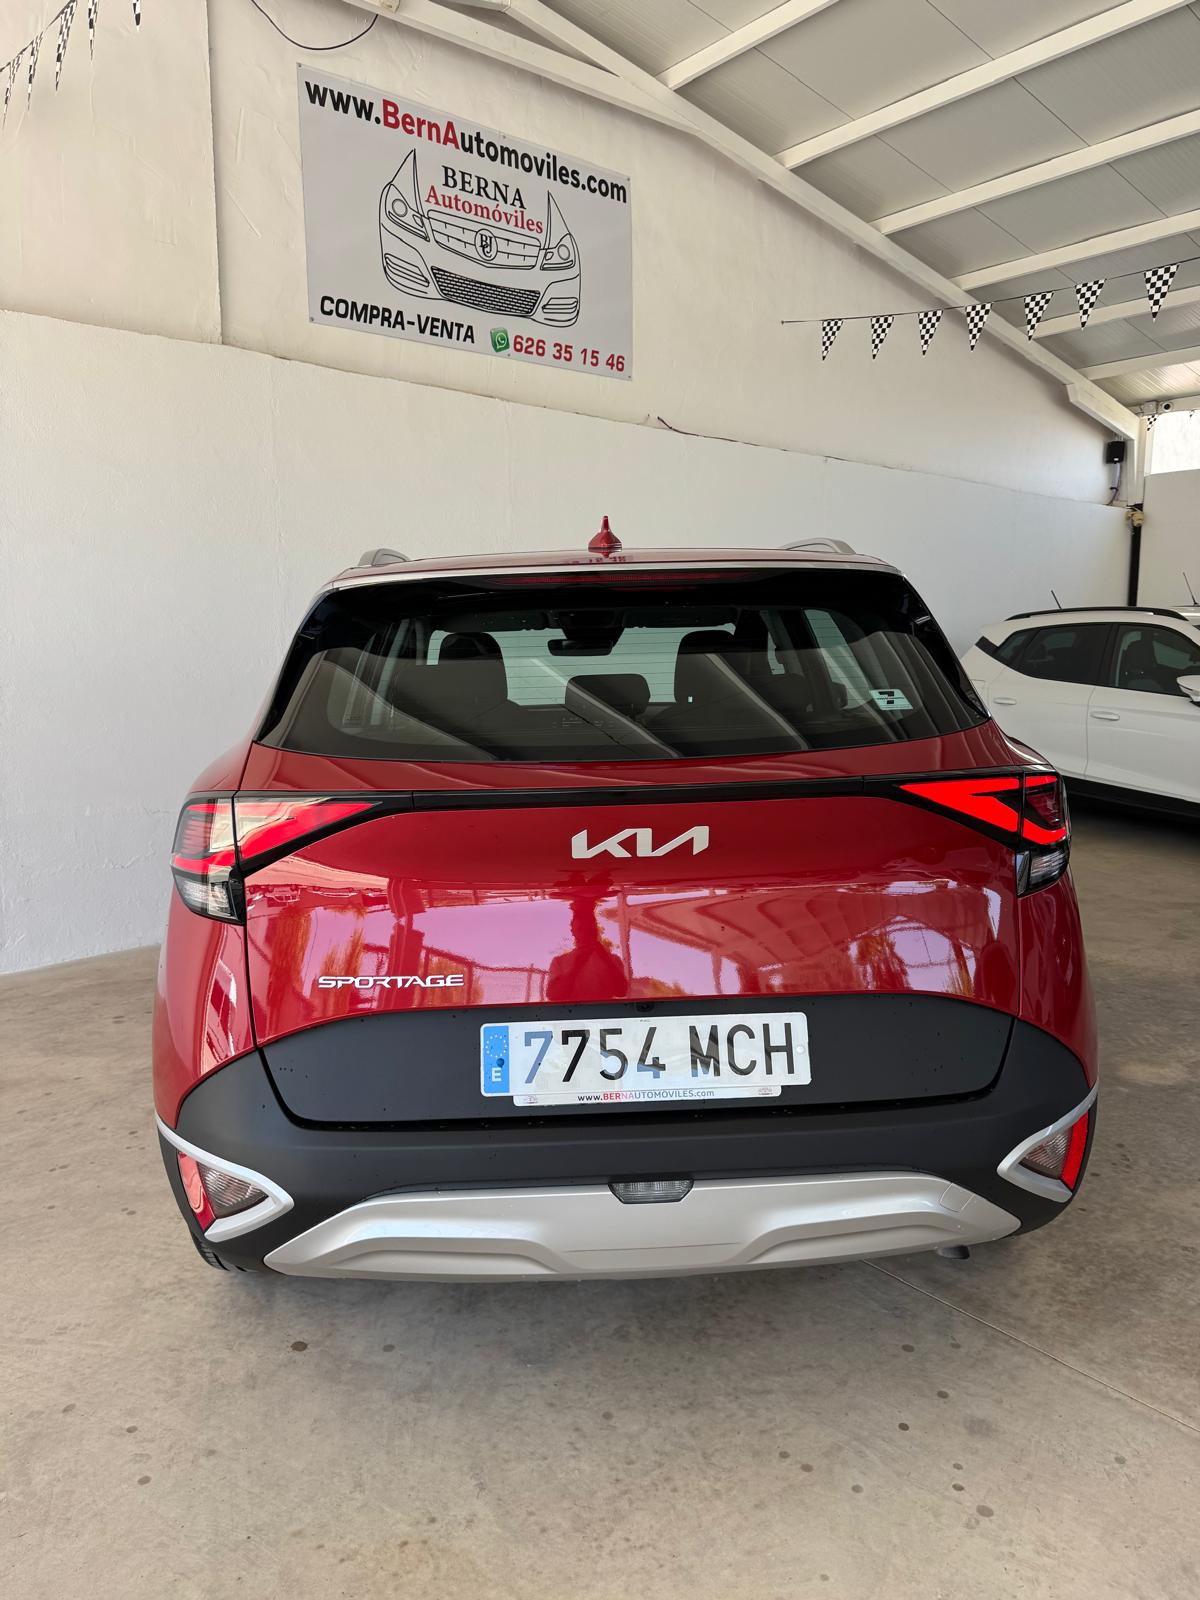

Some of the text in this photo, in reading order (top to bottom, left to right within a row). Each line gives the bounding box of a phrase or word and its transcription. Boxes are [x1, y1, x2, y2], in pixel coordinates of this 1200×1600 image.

[304, 80, 628, 204] www.BernAutomoviles.com
[424, 184, 544, 234] Automóviles
[441, 165, 527, 210] BERNA
[319, 295, 476, 344] COMPRA-VENTA
[512, 334, 626, 373] 626 35 15 46
[571, 825, 709, 859] KIA
[318, 974, 465, 989] SPORTAGE
[491, 1067, 502, 1083] E
[523, 1022, 796, 1084] 7754 MCH
